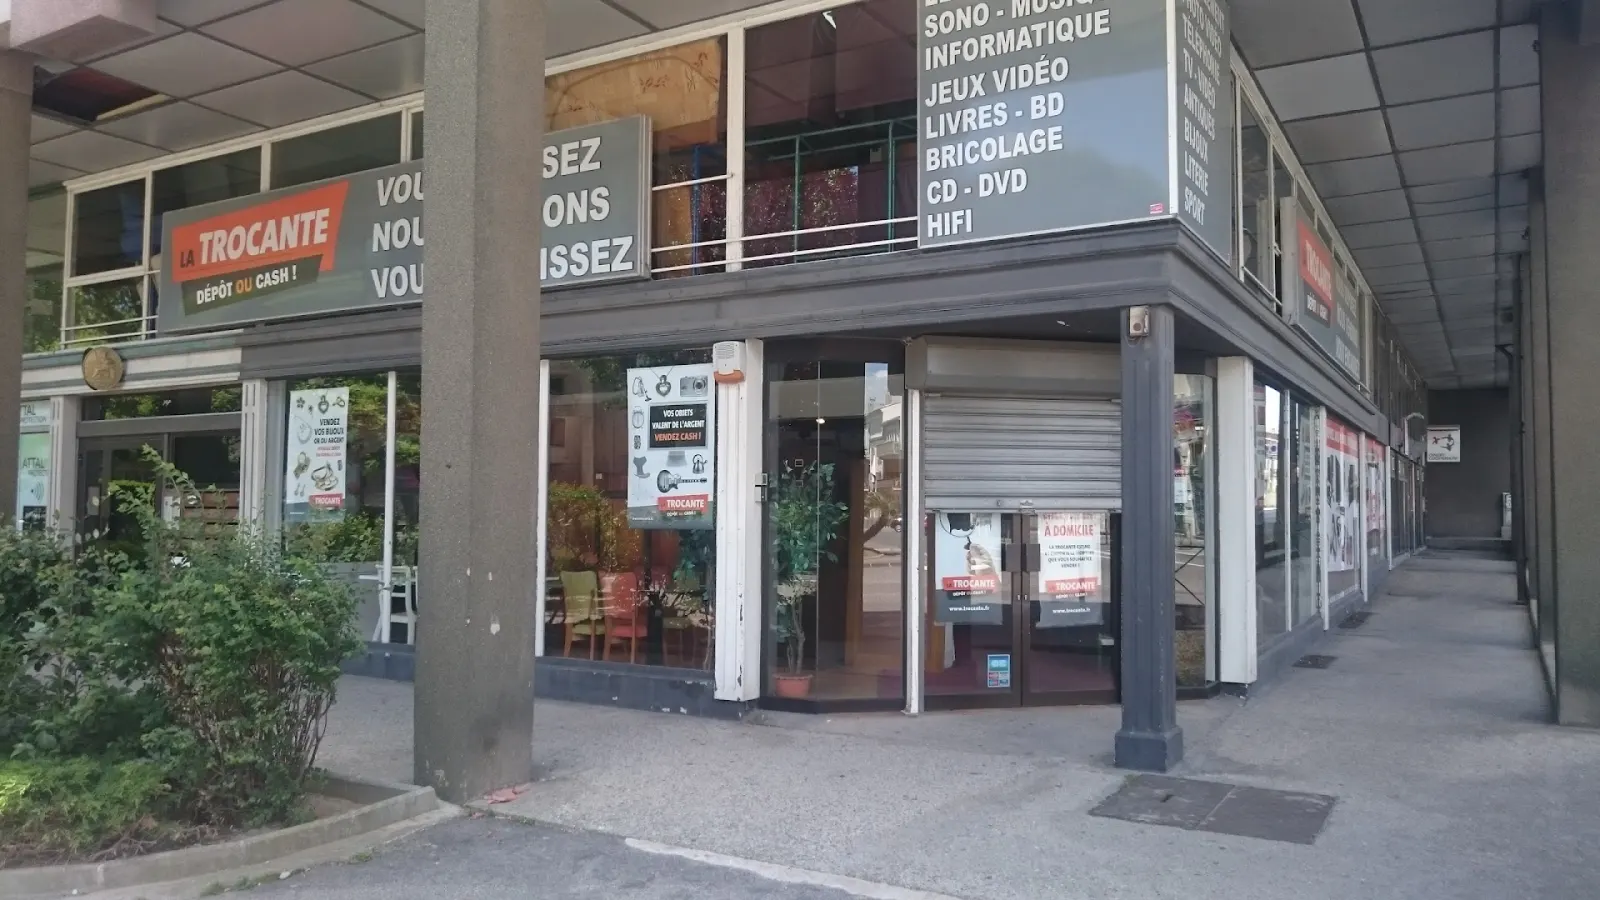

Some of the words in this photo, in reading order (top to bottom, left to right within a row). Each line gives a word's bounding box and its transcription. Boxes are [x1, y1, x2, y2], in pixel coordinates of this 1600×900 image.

[925, 2, 989, 38] SONO
[925, 9, 1110, 71] INFORMATIQUE
[925, 72, 986, 107] JEUX
[992, 54, 1069, 93] VIDÉO
[1183, 47, 1193, 79] TV
[925, 101, 1008, 139] LIVRES
[1030, 91, 1065, 120] BD
[926, 126, 1064, 172] BRICOLAGE
[1184, 116, 1208, 165] BIJOUX
[377, 172, 424, 206] VOU
[542, 137, 602, 179] SEZ
[927, 178, 958, 205] CD
[979, 168, 1028, 198] DVD
[1185, 150, 1208, 197] LITERIE
[372, 216, 424, 252] NOU
[543, 187, 610, 228] ONS
[927, 209, 973, 238] HIFI
[1184, 185, 1206, 226] SPORT
[180, 250, 195, 268] LA
[200, 208, 330, 265] TROCANTE
[196, 281, 233, 305] DÉPÔT
[235, 277, 252, 294] OU
[256, 267, 289, 289] CASH
[292, 265, 297, 280] !
[371, 263, 424, 298] VOU
[540, 236, 634, 280] ISSEZ
[320, 418, 340, 426] VENDEZ
[652, 421, 672, 429] VALENT
[672, 421, 679, 429] DE
[680, 420, 705, 429] L'ARGENT
[675, 409, 693, 417] OBJETS
[314, 428, 325, 436] VOS
[326, 427, 344, 435] BIJOUX
[654, 433, 680, 442] VENDEZ
[680, 432, 698, 441] CASH
[315, 496, 340, 505] TROCANTE
[667, 499, 704, 509] TROCANTE
[1044, 522, 1051, 537] À
[1053, 524, 1094, 537] DOMICILE
[953, 579, 996, 588] TROCANTE
[1056, 581, 1096, 591] TROCANTE
